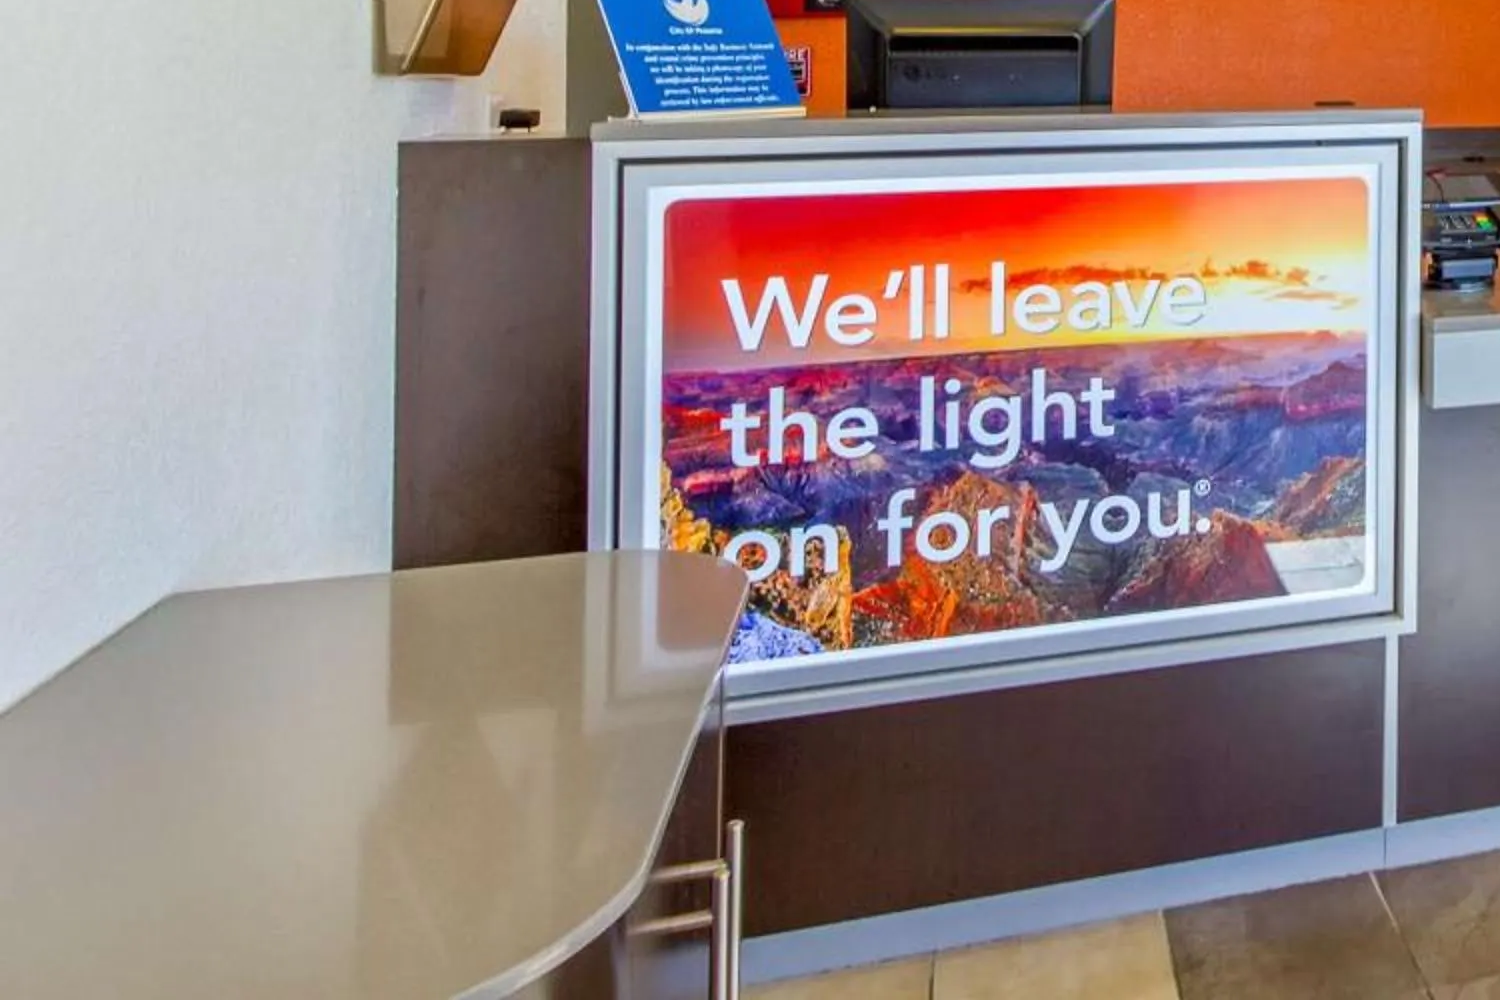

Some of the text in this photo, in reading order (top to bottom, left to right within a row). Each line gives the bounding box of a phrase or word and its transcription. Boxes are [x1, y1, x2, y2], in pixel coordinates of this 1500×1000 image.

[720, 260, 1208, 353] We'll leave
[720, 368, 1116, 470] the light
[723, 521, 839, 582] on
[877, 488, 1011, 568] for
